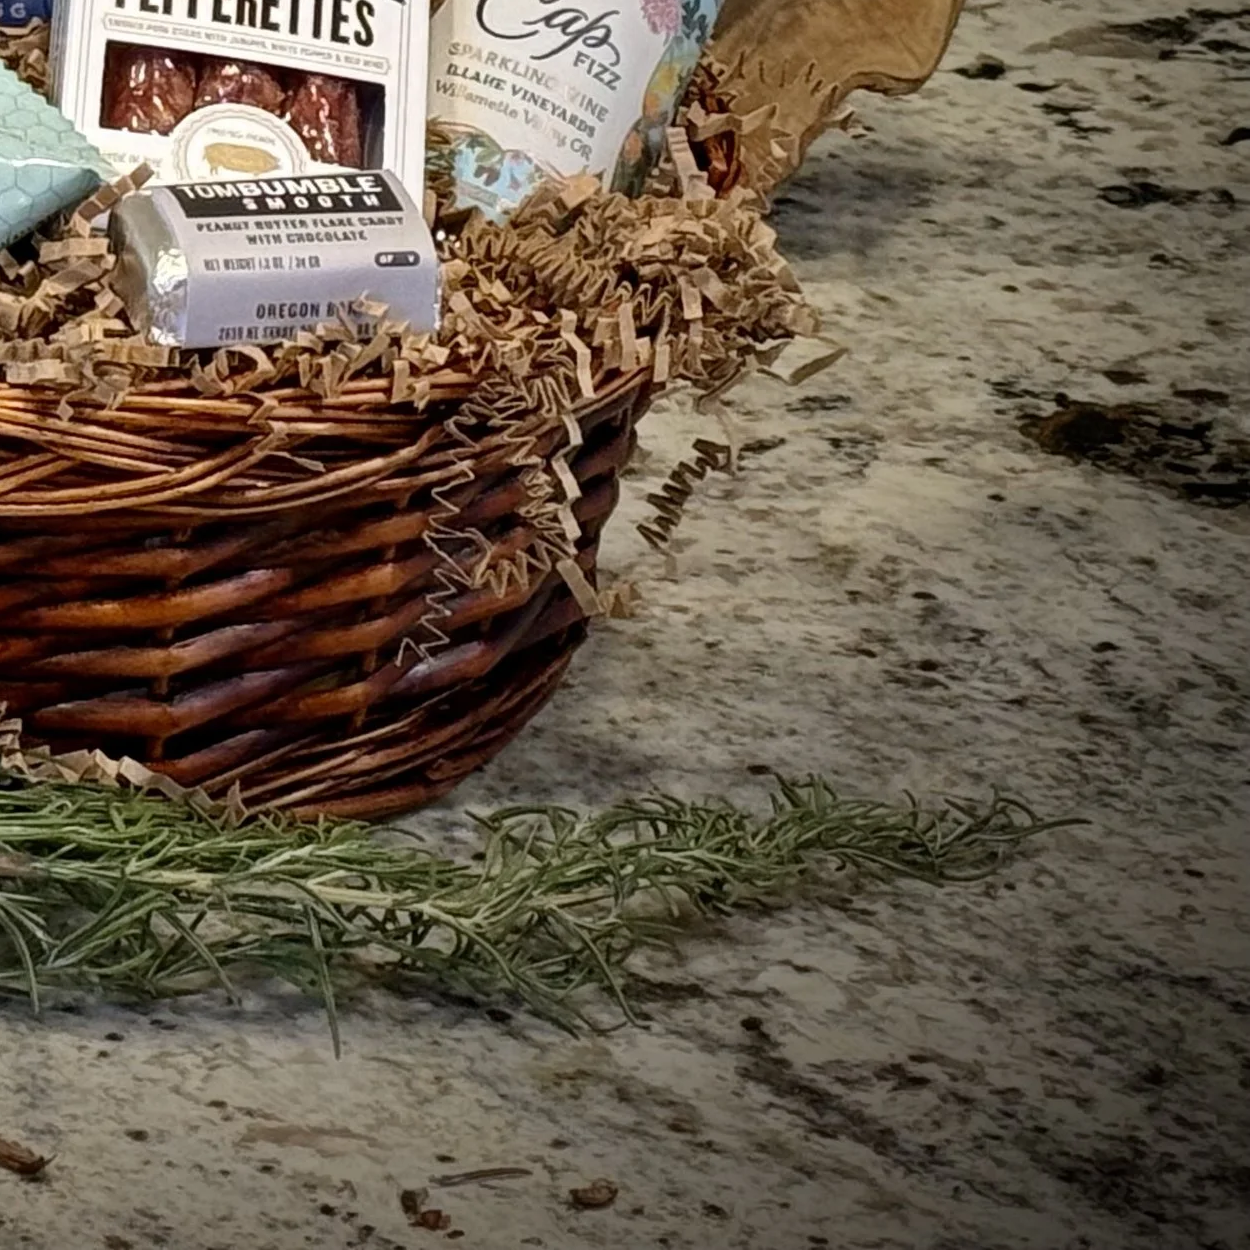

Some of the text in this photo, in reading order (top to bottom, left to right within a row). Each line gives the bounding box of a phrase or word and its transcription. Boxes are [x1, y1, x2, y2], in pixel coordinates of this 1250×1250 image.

[448, 41, 610, 123] SPARKLING WINE
[573, 51, 622, 92] FIZZ
[510, 83, 597, 139] VINEYARDS
[176, 174, 383, 201] TOMBUMBLE
[243, 194, 382, 212] SMOOTH
[196, 215, 405, 233] PEANUT BUTTER FLAKE CANDY
[246, 229, 368, 246] WITH CHOCOLATE
[256, 302, 321, 320] OREGON
